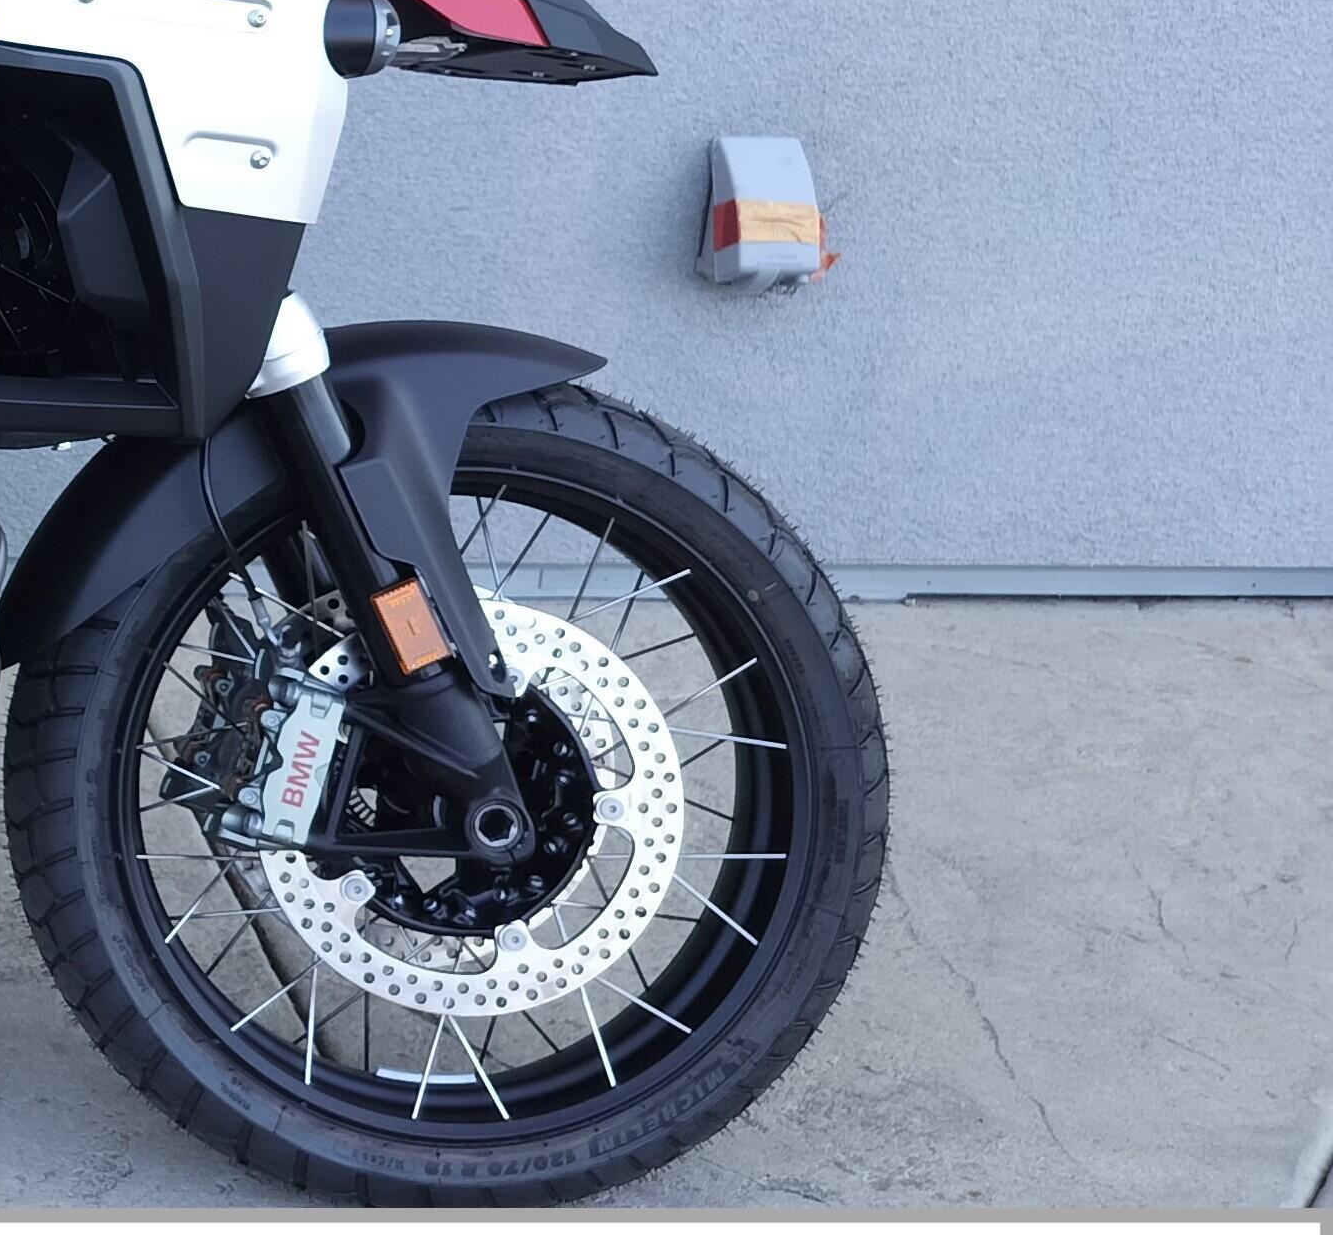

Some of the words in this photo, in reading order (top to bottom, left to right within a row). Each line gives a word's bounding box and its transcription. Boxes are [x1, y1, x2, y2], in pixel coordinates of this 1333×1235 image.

[281, 730, 321, 808] BMW
[597, 1066, 726, 1153] MICHELIN
[487, 1148, 577, 1177] 120/70
